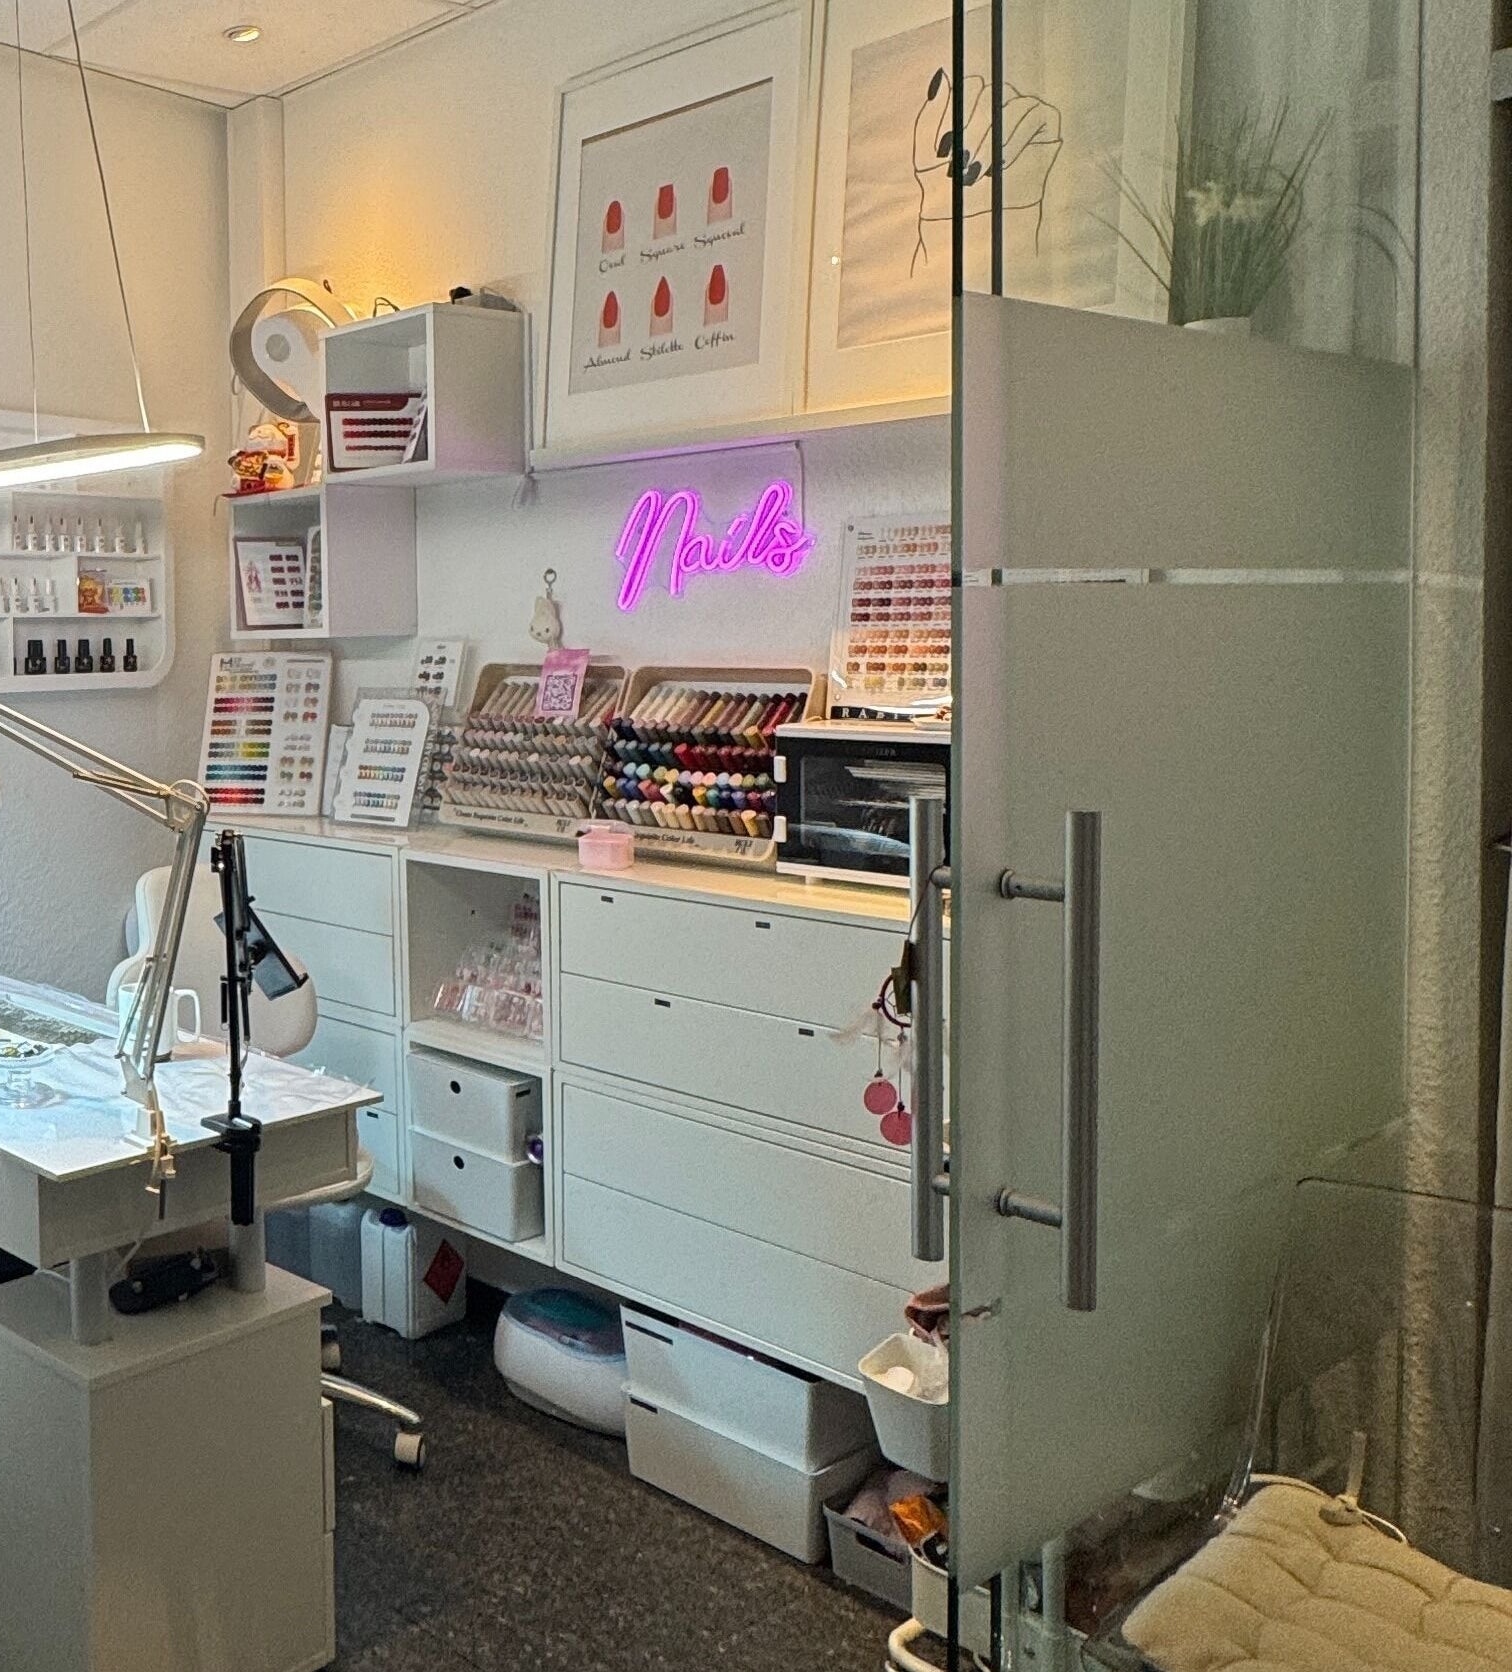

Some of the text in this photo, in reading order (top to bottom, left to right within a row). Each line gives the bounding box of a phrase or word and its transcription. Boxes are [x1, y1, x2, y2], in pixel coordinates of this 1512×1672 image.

[640, 242, 685, 264] Square
[583, 349, 631, 372] Almond
[694, 331, 734, 350] Coffin
[615, 481, 814, 611] Nails
